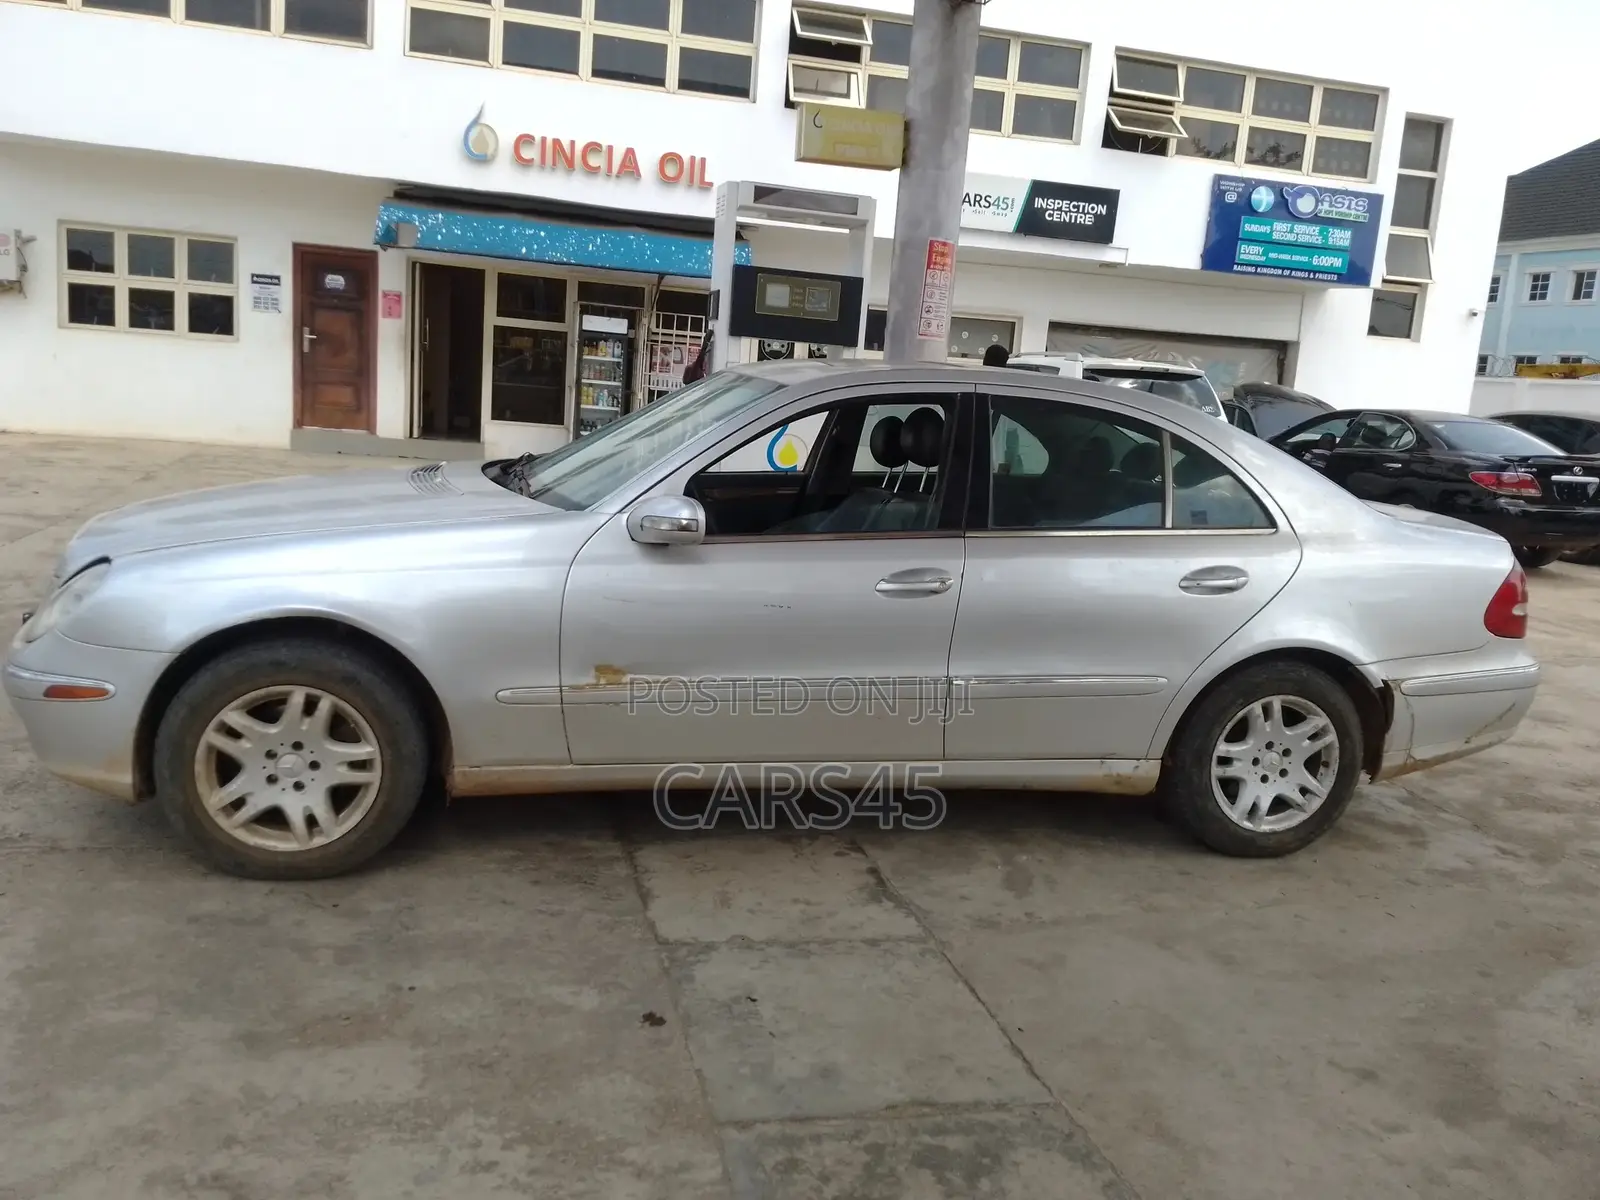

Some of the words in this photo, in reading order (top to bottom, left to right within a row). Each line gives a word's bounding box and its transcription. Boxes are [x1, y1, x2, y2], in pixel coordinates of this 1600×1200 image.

[513, 133, 642, 179] CINCIA
[658, 151, 714, 189] OIL
[961, 192, 1010, 211] ARS45
[1034, 197, 1107, 215] INSPECTION
[1045, 210, 1094, 225] CENTRE
[1244, 223, 1271, 233] SUNDAYS
[1273, 222, 1292, 232] FIRST
[1293, 223, 1320, 235] SERVICE
[1272, 231, 1297, 241] SECOND
[1297, 233, 1323, 244] SERVICE
[1240, 244, 1264, 255] EVERY
[1312, 254, 1343, 268] 6:00PM
[1233, 264, 1256, 273] RAISING
[1257, 266, 1282, 275] KINGDOM
[1291, 269, 1309, 278] KINGS
[1315, 272, 1338, 281] PRIESTS
